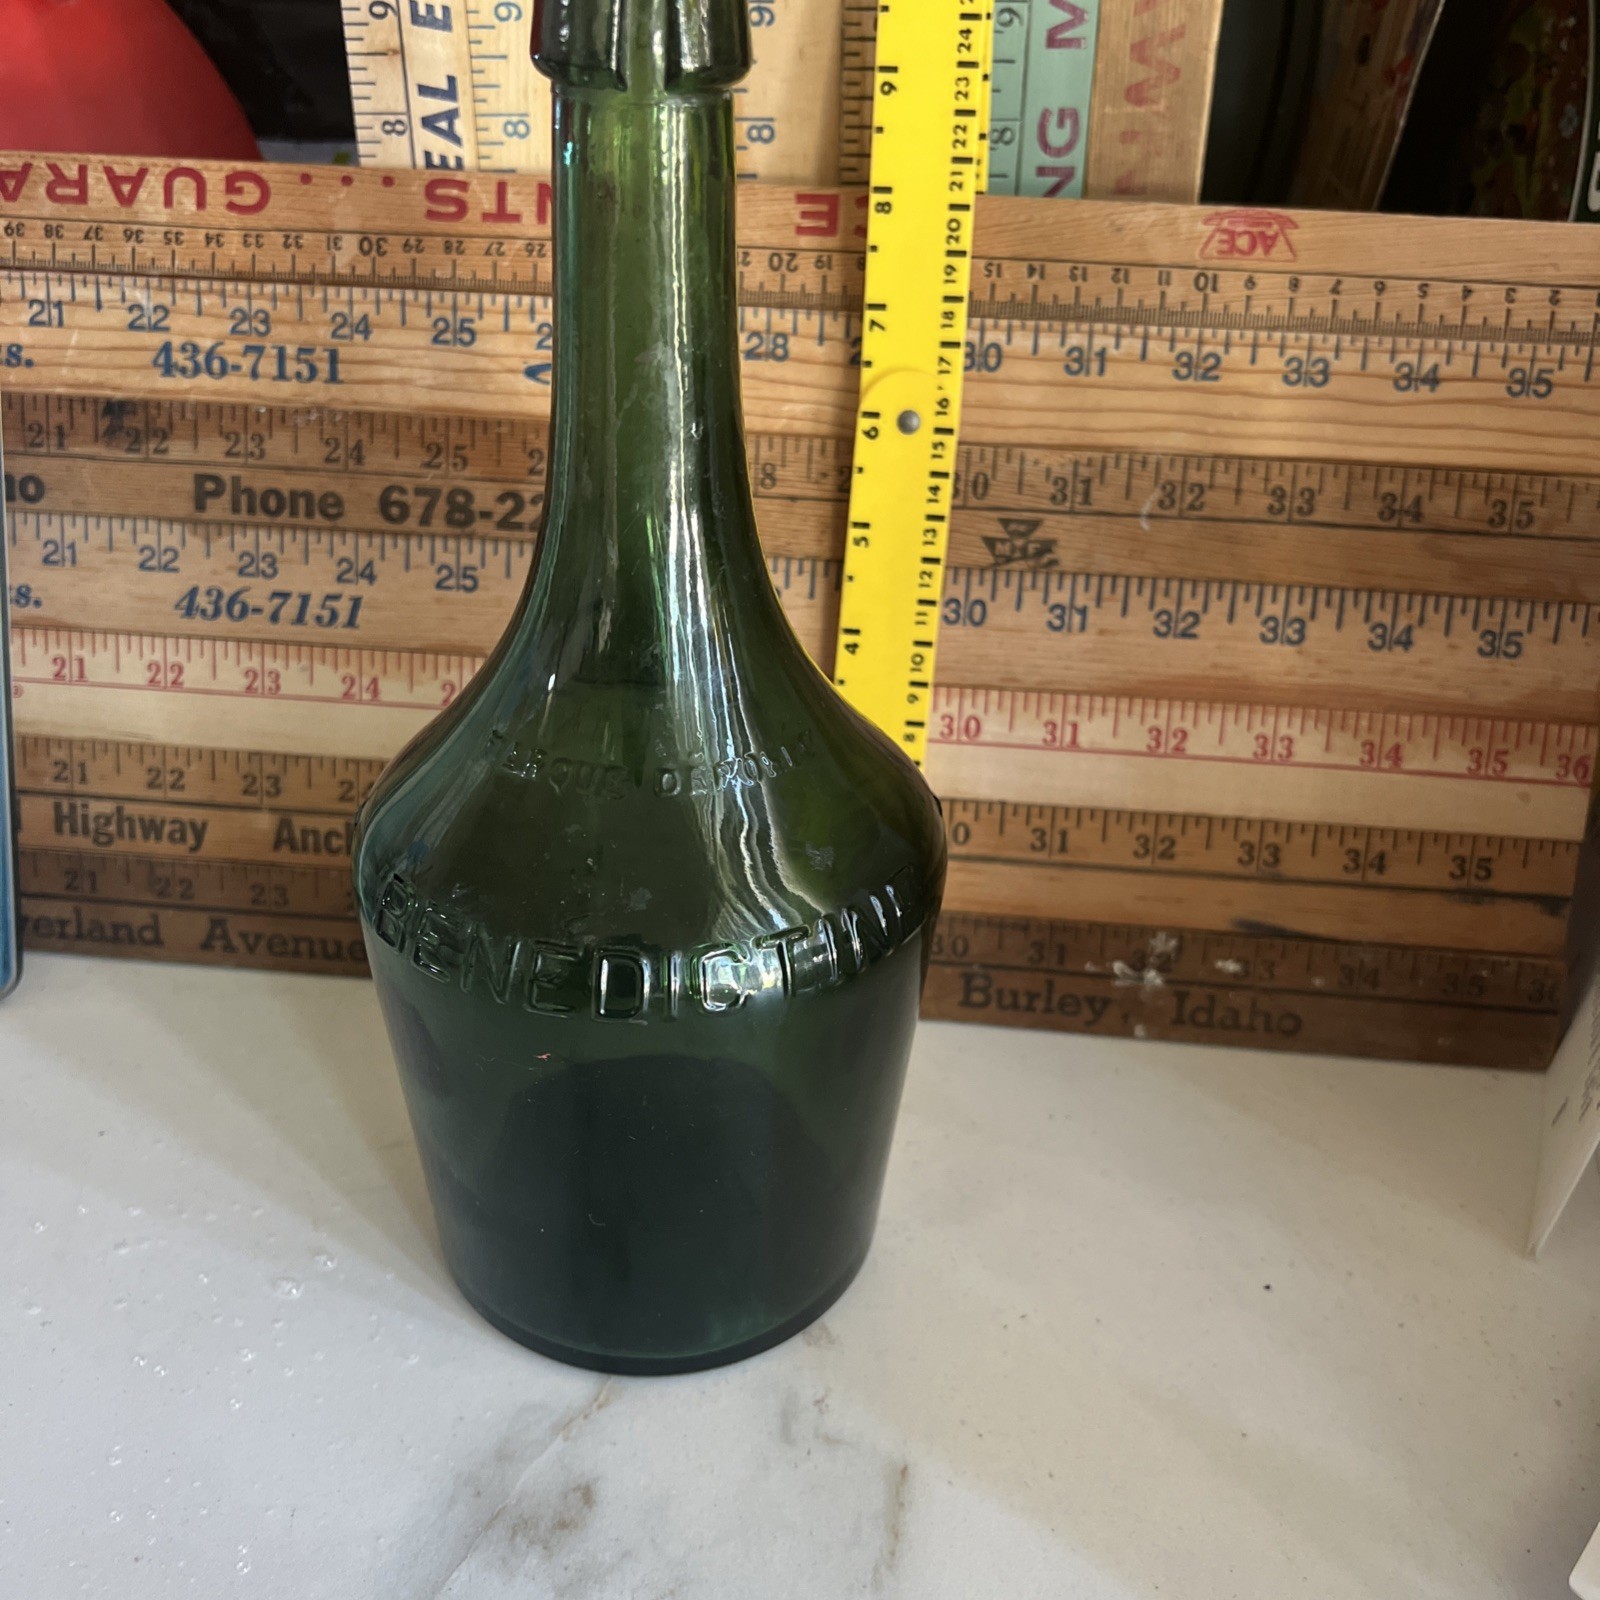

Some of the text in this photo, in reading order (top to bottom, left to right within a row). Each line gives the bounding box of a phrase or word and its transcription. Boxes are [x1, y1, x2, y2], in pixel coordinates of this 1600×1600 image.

[410, 0, 454, 32] E
[368, 1, 407, 136] 8 9
[494, 1, 531, 140] 8 9
[989, 7, 1023, 146] 8 9
[746, 124, 776, 144] 8
[4, 221, 25, 237] 39
[44, 223, 64, 239] 38
[83, 225, 104, 241] 37
[123, 227, 144, 244] 36
[163, 230, 184, 246] 35
[204, 232, 225, 248] 34
[242, 233, 264, 249] 33
[283, 234, 303, 249] 32
[326, 235, 343, 251] 31
[359, 236, 388, 257] 30
[401, 238, 425, 254] 29
[1216, 228, 1281, 257] ACE
[444, 240, 464, 256] 28
[483, 241, 506, 257] 27
[524, 243, 547, 258] 26
[768, 252, 799, 272] 20
[814, 255, 833, 270] 19
[983, 262, 1002, 278] 15
[1027, 263, 1045, 280] 14
[1068, 265, 1087, 282] 13
[1111, 267, 1130, 284] 12
[1157, 269, 1172, 286] 11
[1193, 271, 1218, 293] 10
[1244, 275, 1257, 290] 9
[1288, 277, 1299, 292] 8
[1329, 279, 1343, 295] 7
[1373, 280, 1386, 296] 6
[1417, 282, 1429, 299] 5
[1462, 284, 1474, 301] 4
[1505, 287, 1517, 304] 3
[1549, 289, 1562, 306] 2
[28, 300, 64, 327] 21
[127, 303, 170, 331] 22
[229, 307, 272, 337] 23
[331, 312, 373, 341] 24
[431, 317, 477, 347] 25
[535, 322, 553, 350] 2
[743, 331, 789, 362] 28
[1063, 346, 1107, 377] 31
[1172, 350, 1222, 382] 32
[1282, 356, 1330, 388] 33
[1393, 362, 1441, 392] 34
[1506, 367, 1555, 399] 35
[152, 341, 345, 385] 436-7151
[844, 81, 897, 655] 4 5 6 7 8 9
[903, 28, 972, 742] 8 9 10 11 12 13 14 15 16 17 18 19 20 21 22 23 24
[27, 422, 66, 450] 21
[125, 428, 169, 454] 22
[224, 431, 266, 460] 23
[323, 437, 365, 466] 24
[421, 441, 469, 472] 25
[1051, 476, 1093, 506] 31
[1157, 480, 1205, 512] 32
[1267, 484, 1315, 516] 33
[1378, 491, 1424, 523] 34
[1487, 498, 1534, 530] 35
[193, 472, 345, 521] Phone
[42, 539, 1524, 660] 21 22 23 24 25 30 31 32 33 34 35
[174, 584, 364, 630] 436-7151
[51, 655, 88, 683] 21
[147, 660, 185, 688] 22
[243, 668, 281, 695] 23
[341, 675, 380, 702] 24
[939, 714, 982, 742] 30
[1042, 721, 1081, 748] 31
[1146, 726, 1189, 755] 32
[1253, 732, 1295, 762] 33
[1359, 739, 1403, 769] 34
[1466, 746, 1509, 777] 35
[1555, 753, 1592, 785] 36
[53, 760, 88, 785] 21
[146, 766, 186, 791] 22
[241, 771, 282, 798] 23
[1030, 828, 1069, 854] 31
[1132, 834, 1176, 860] 32
[1237, 840, 1281, 868] 33
[1342, 847, 1387, 875] 34
[1450, 854, 1493, 882] 35
[53, 801, 208, 853] Highway
[64, 868, 97, 893] 21
[250, 882, 289, 908] 23
[1027, 938, 1067, 966] 31
[1170, 989, 1303, 1037] Idaho
